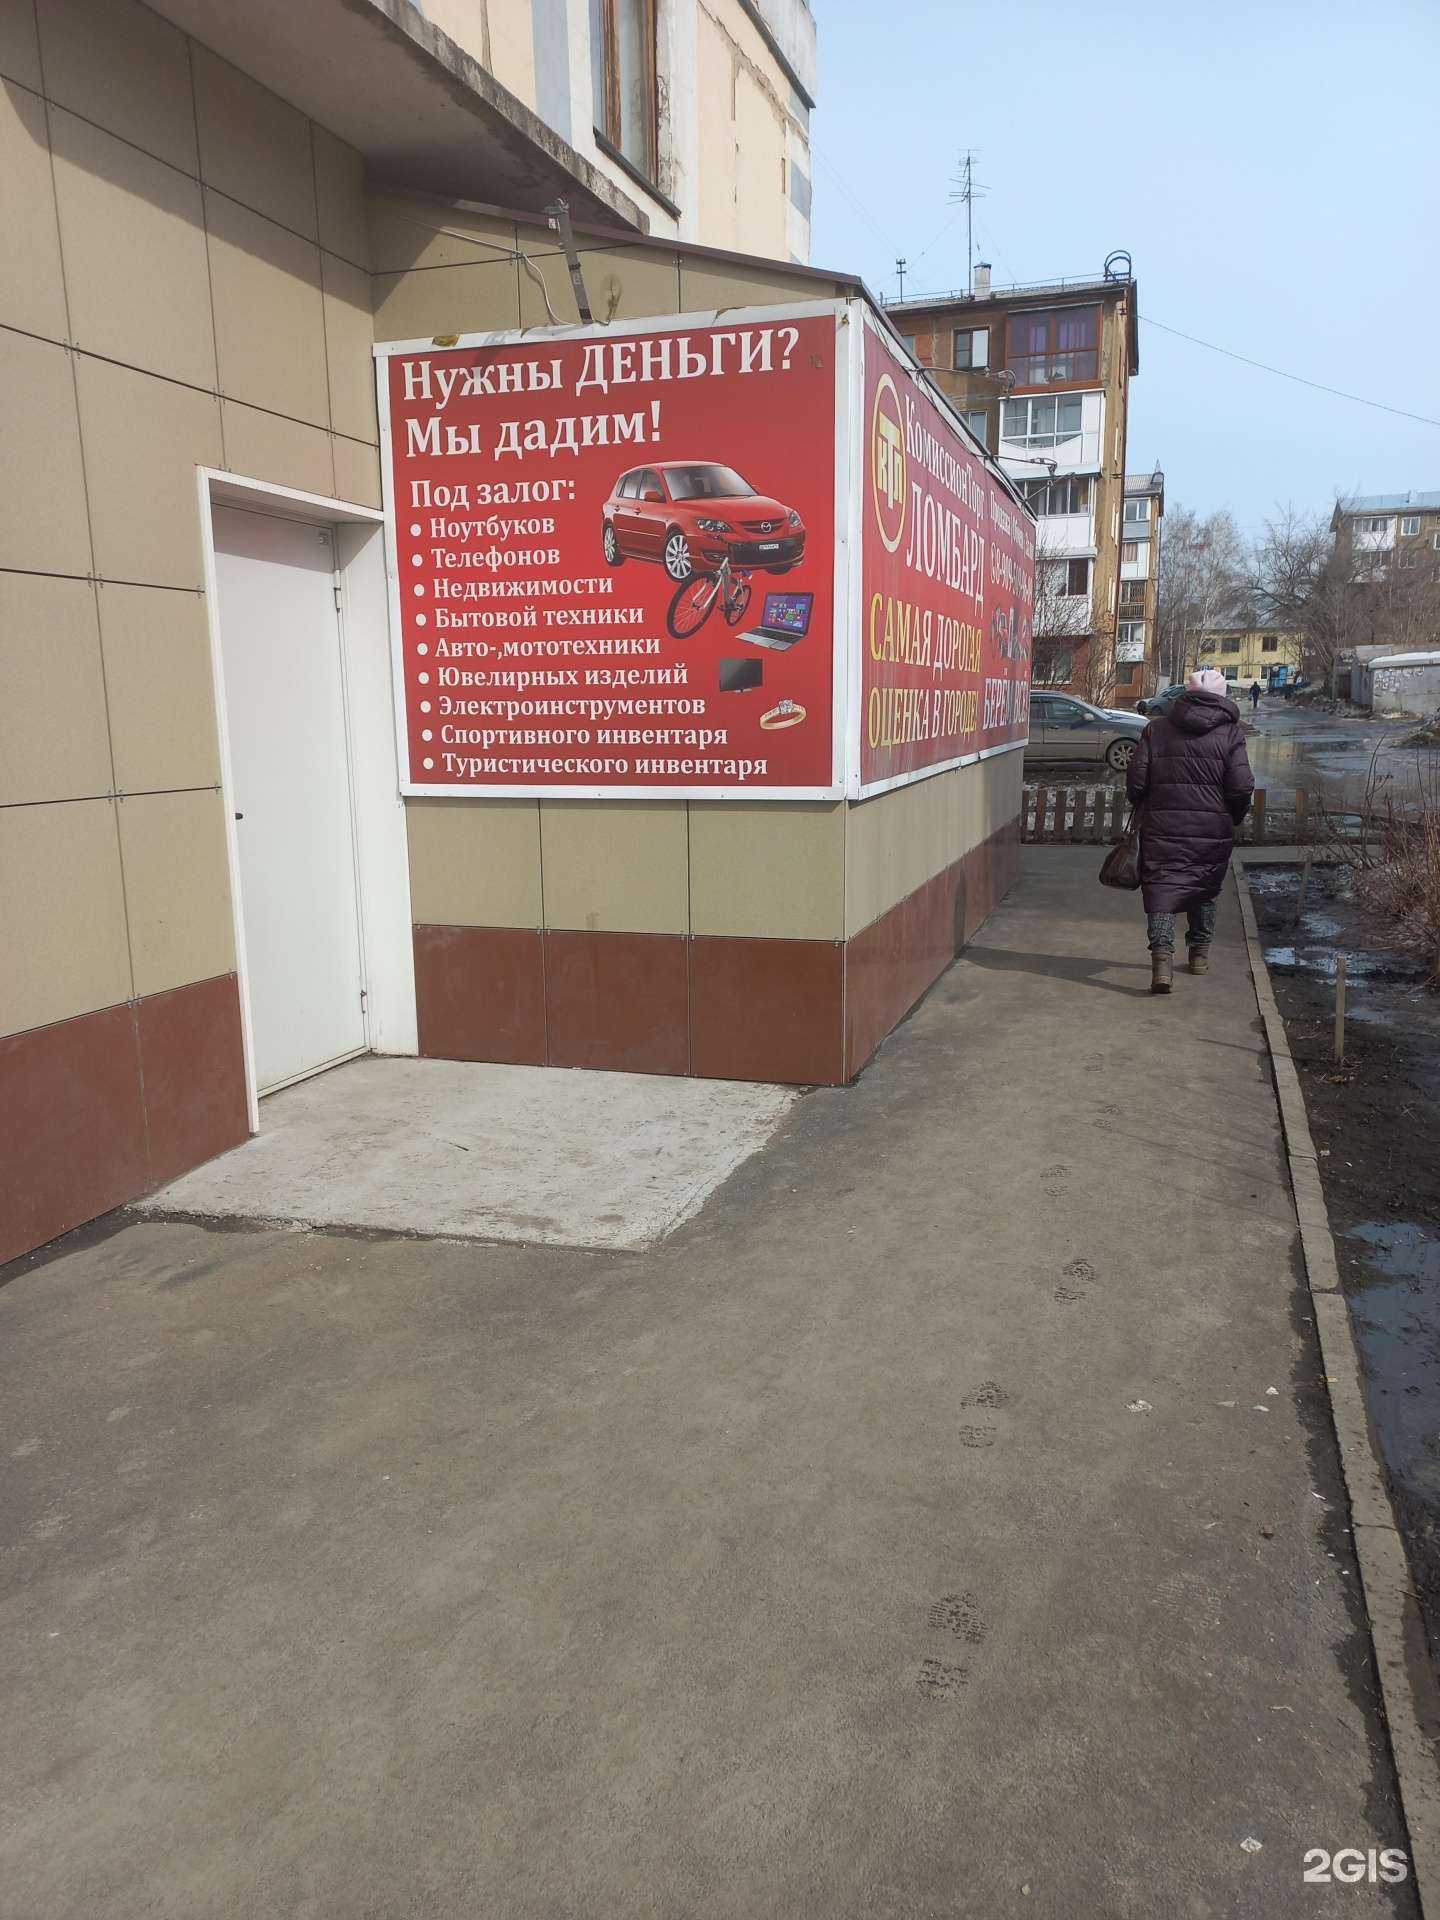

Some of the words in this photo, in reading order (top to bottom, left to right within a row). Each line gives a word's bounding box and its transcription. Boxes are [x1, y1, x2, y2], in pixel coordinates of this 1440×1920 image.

[402, 358, 563, 409] Нужны
[575, 327, 799, 396] ДЕНЬГИ?
[405, 416, 482, 458] Мы
[494, 400, 661, 460] дадим!
[411, 479, 470, 511] Под
[476, 477, 577, 507] залог:
[430, 517, 556, 543] Ноутбуков
[431, 546, 561, 573] Телефонов
[906, 481, 985, 619] ЛОМБАРД
[433, 575, 614, 600] Недвижимости
[435, 603, 537, 629] Бытовой
[543, 606, 644, 626] техники
[435, 638, 661, 660] Авто-,мототехники
[870, 592, 932, 667] САМАЯ
[933, 614, 983, 681] ДОРОГАЯ
[438, 666, 579, 692] Ювелирных
[585, 663, 689, 687] изделий
[439, 696, 706, 719] Электроинструментов
[868, 686, 929, 757] ОЦЕНКА
[932, 689, 943, 738] В
[441, 725, 591, 749] Спортивного
[597, 727, 728, 750] инвентаря
[442, 752, 629, 778] Туристического
[635, 756, 768, 781] инвентаря
